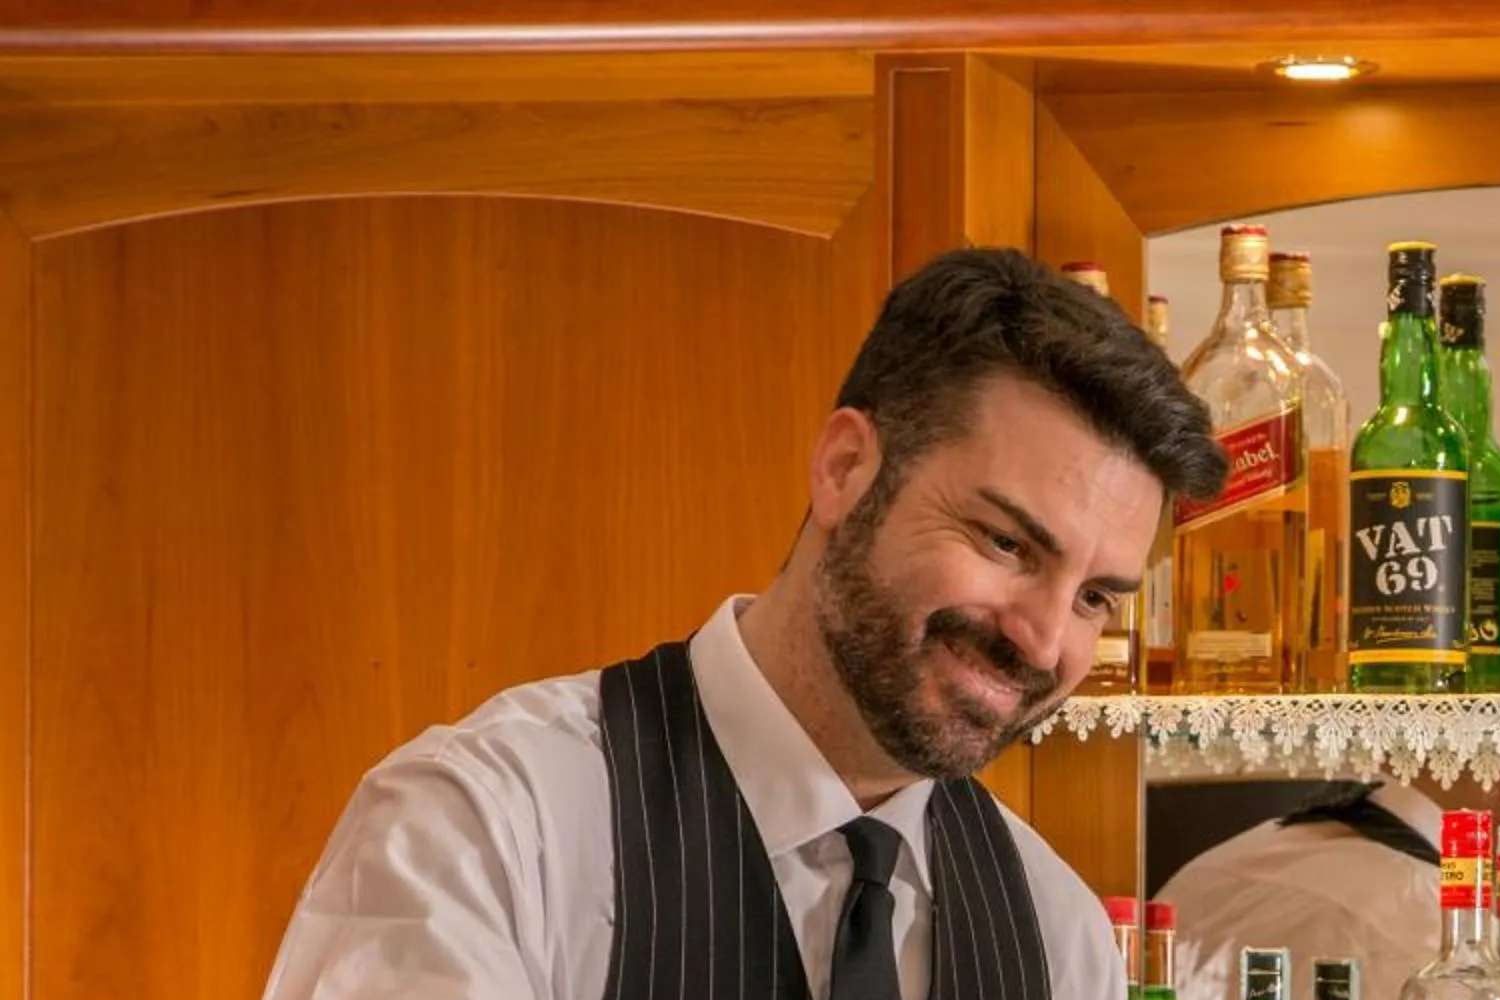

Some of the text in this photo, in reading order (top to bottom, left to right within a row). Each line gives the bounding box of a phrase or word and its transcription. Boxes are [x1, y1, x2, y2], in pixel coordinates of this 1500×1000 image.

[1232, 441, 1276, 476] abel
[1355, 515, 1453, 561] VAT
[1375, 556, 1439, 595] 69
